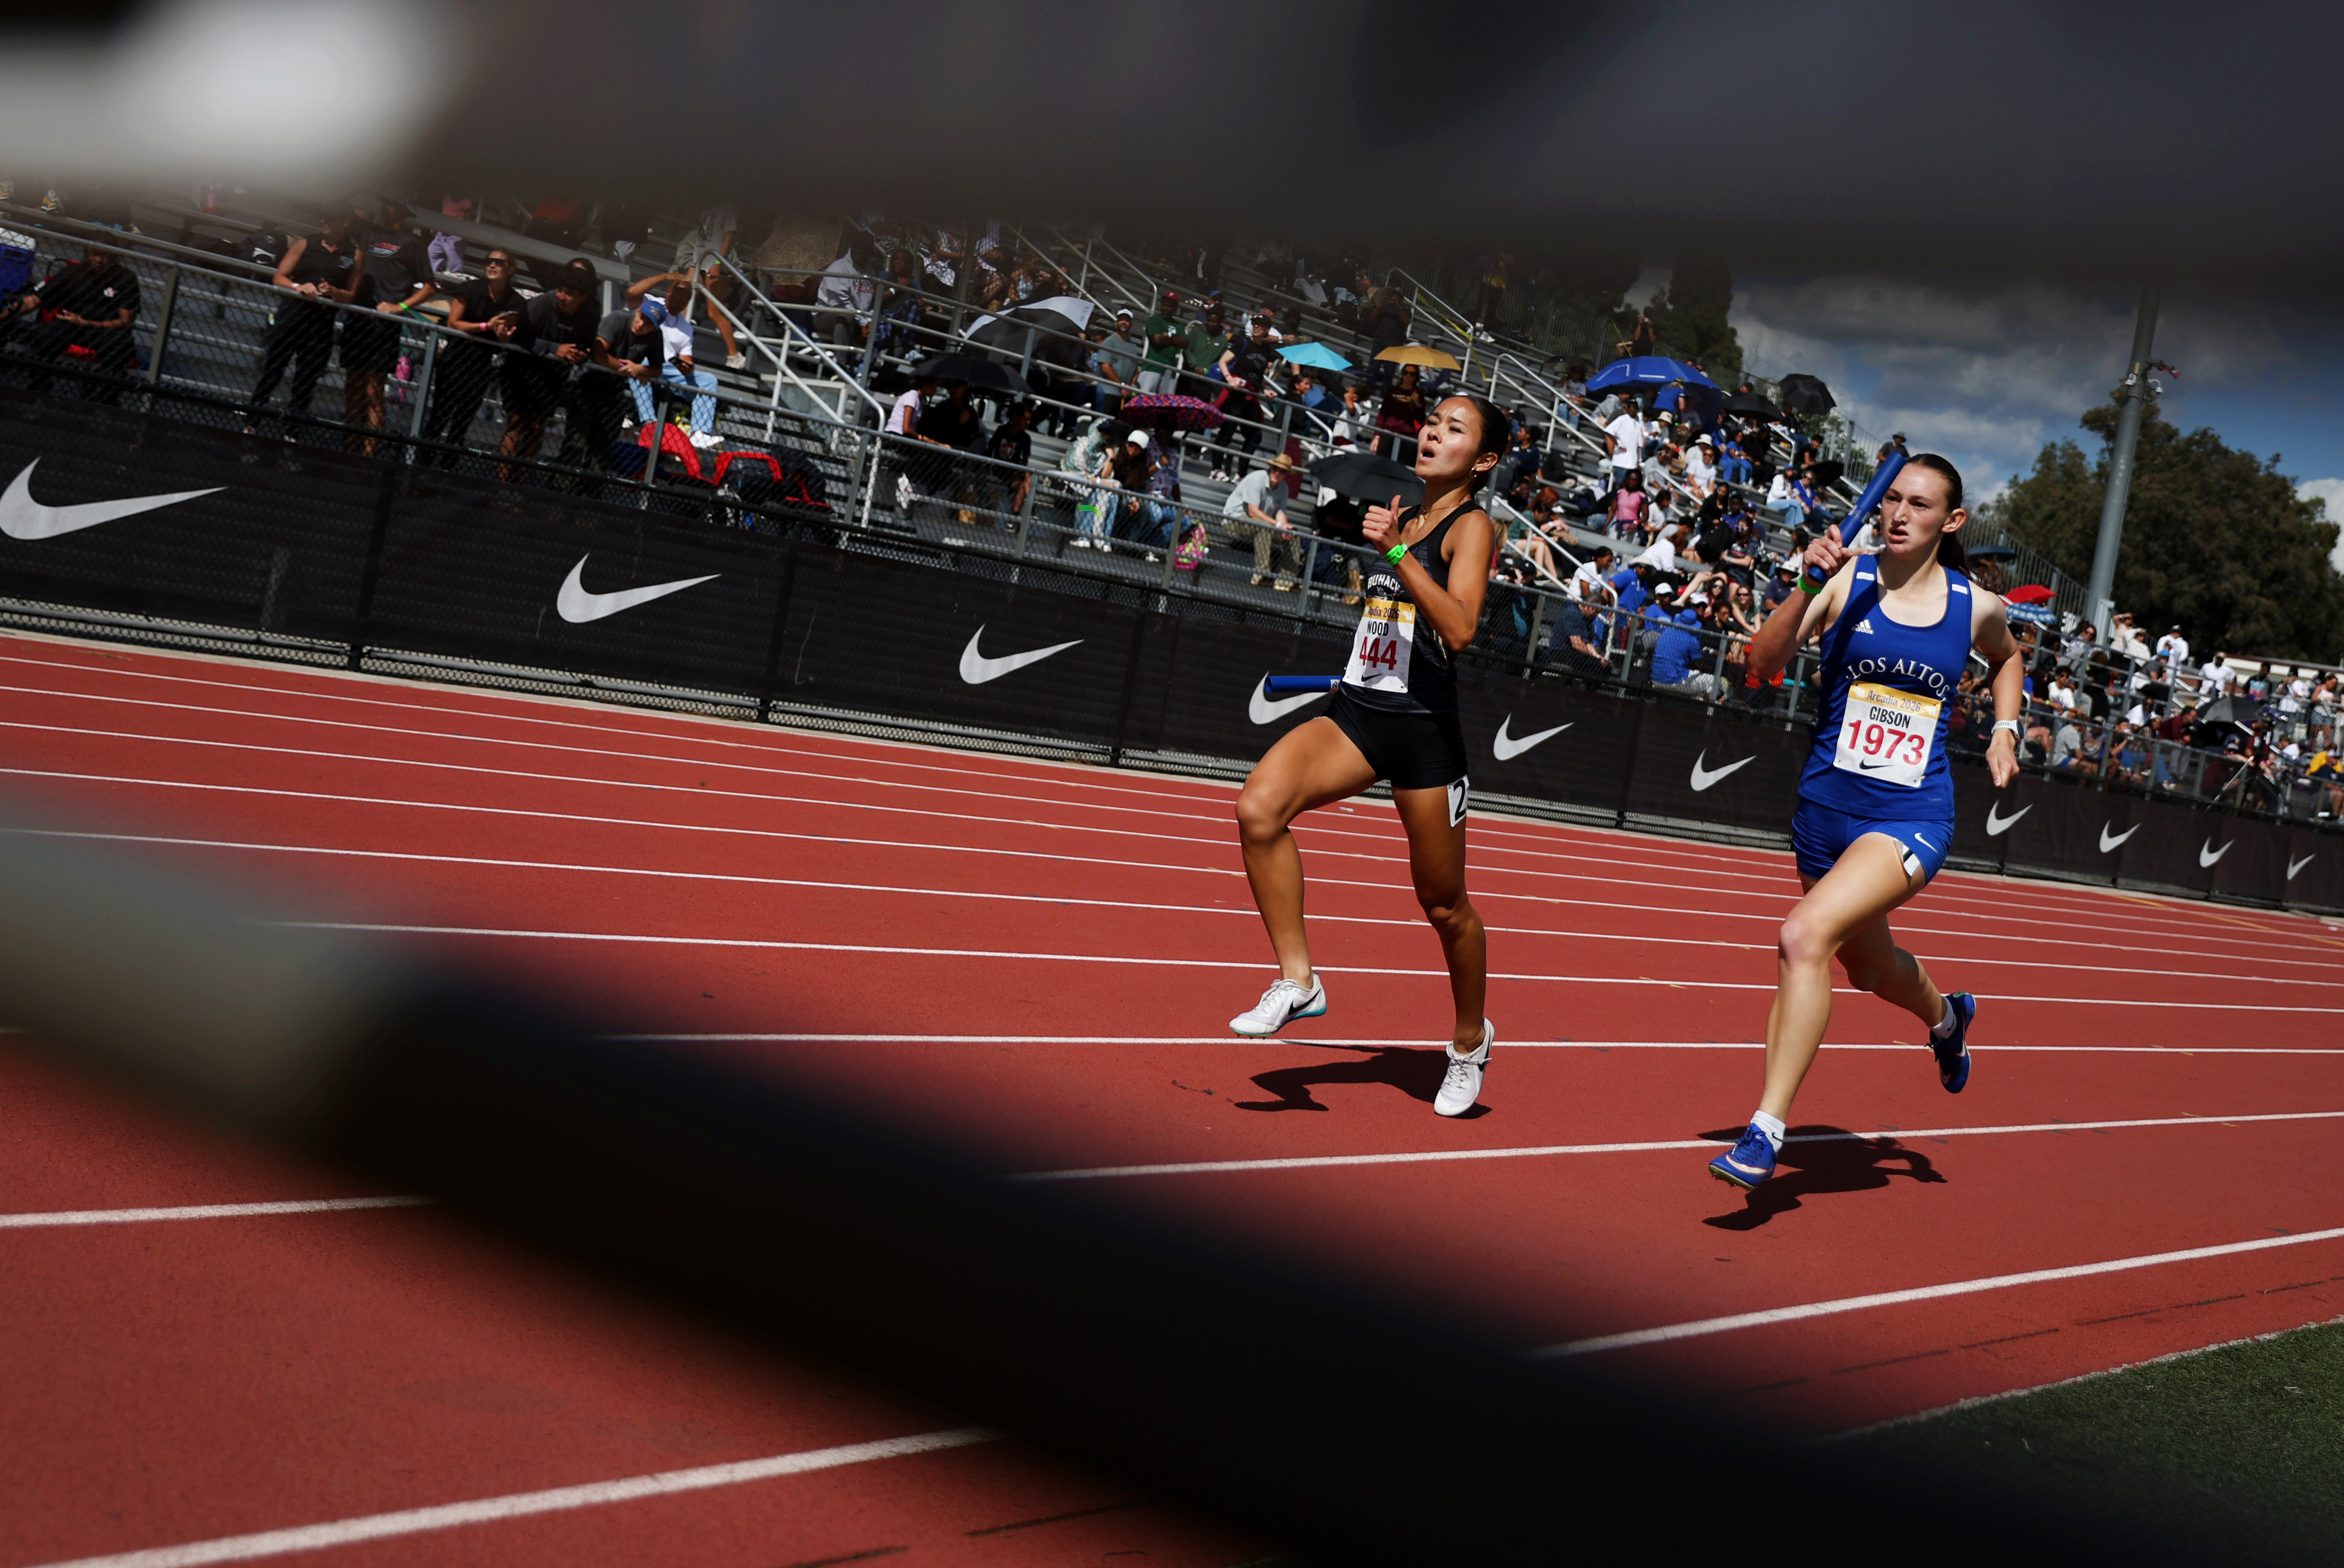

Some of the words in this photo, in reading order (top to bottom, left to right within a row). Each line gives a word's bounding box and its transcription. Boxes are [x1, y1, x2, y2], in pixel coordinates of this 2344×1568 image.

[1383, 607, 1400, 619] 2026
[1367, 621, 1389, 636] WOOD
[1851, 626, 1874, 635] adidas
[1359, 636, 1397, 671] 444
[1847, 657, 1886, 680] LOS
[1890, 658, 1950, 697] ALTOS
[1867, 690, 1898, 707] Arcadia
[1900, 698, 1921, 713] 2026
[1869, 706, 1911, 729] GIBSON
[1848, 719, 1925, 765] 1973
[1453, 779, 1466, 822] 2
